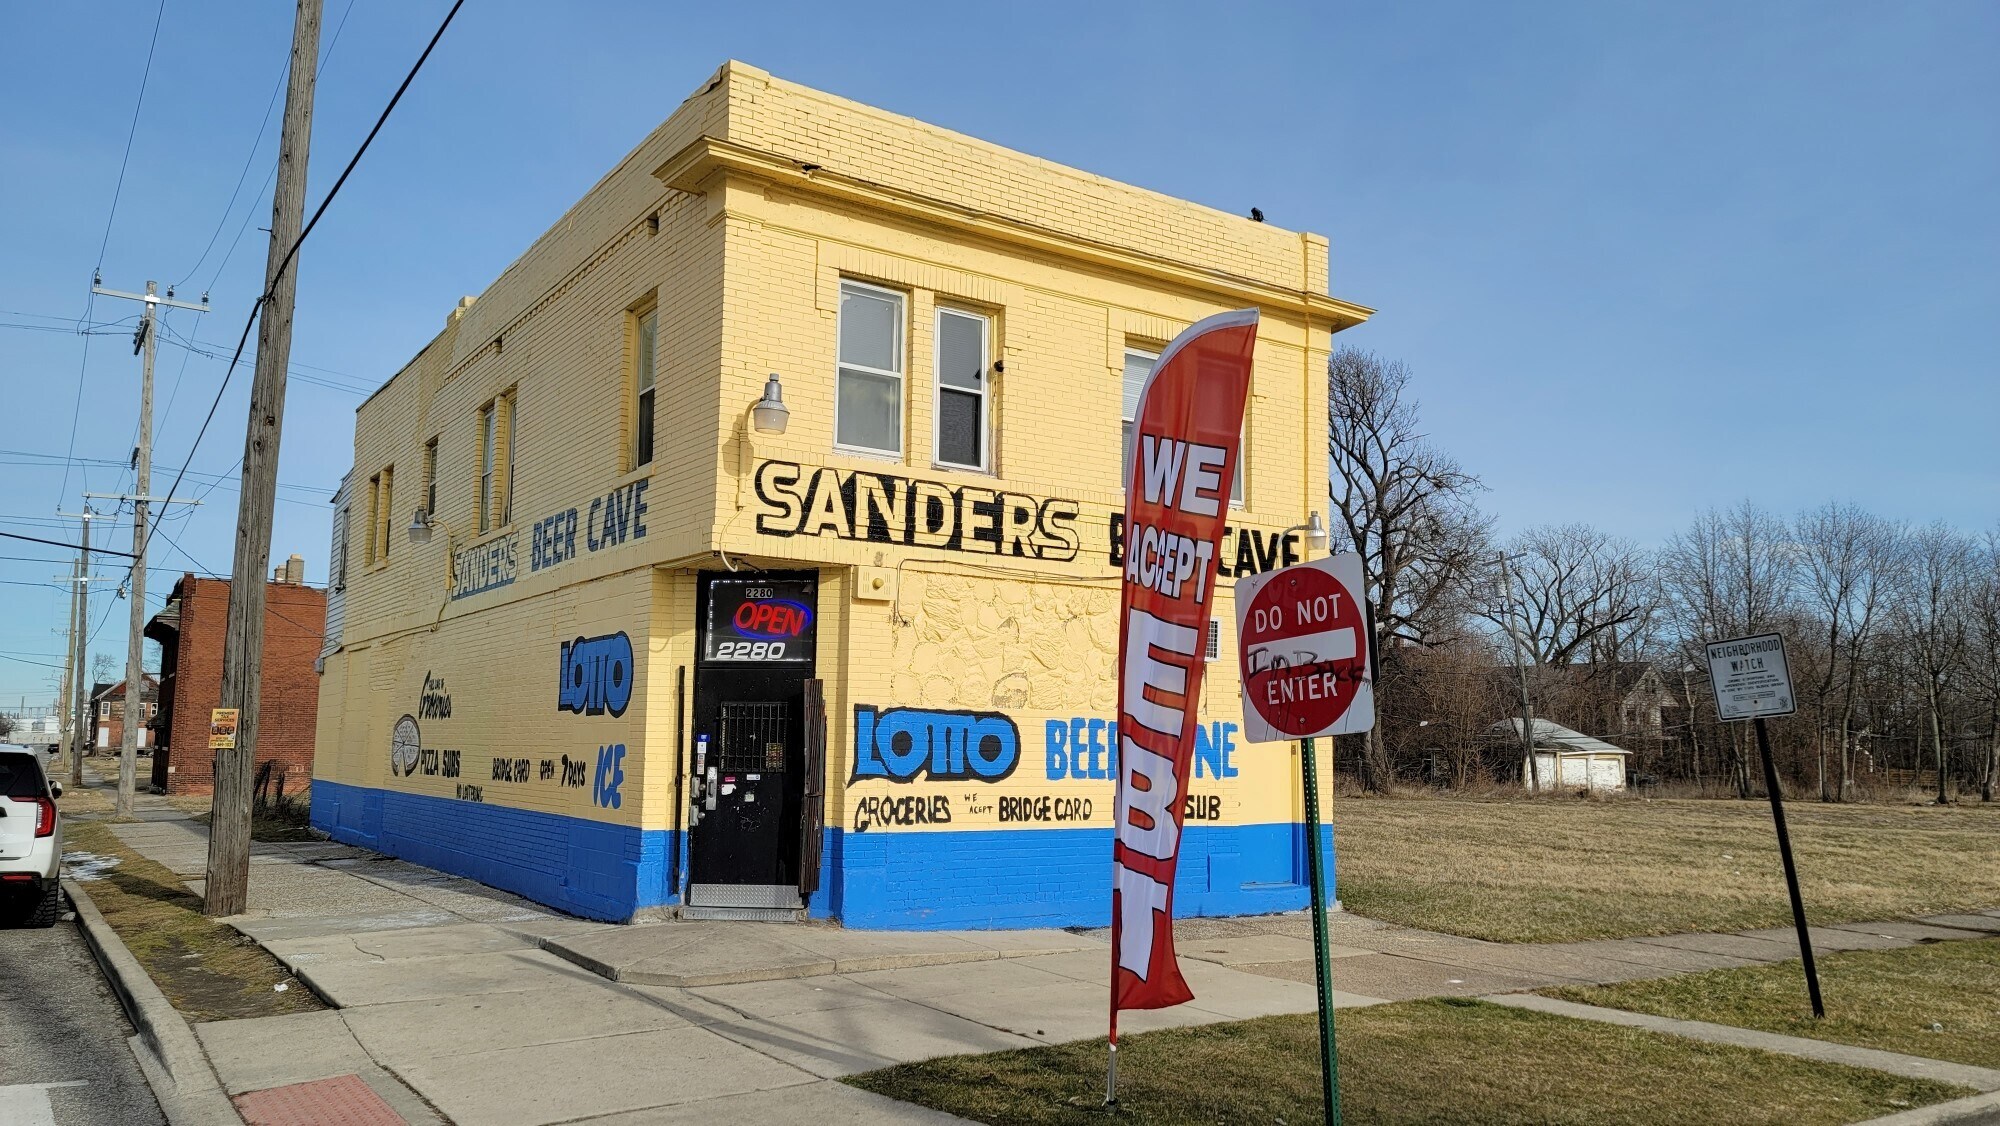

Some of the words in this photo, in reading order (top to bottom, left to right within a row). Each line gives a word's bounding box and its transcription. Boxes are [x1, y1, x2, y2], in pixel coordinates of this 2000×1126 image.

[1141, 433, 1228, 518] WE
[754, 460, 1080, 562] SANDERS
[452, 532, 519, 600] SANDERS
[531, 507, 578, 572] BEER
[587, 478, 649, 552] CAVE
[1126, 523, 1215, 605] ACCEPT
[746, 588, 773, 598] 2280
[735, 602, 805, 636] OPEN
[1254, 605, 1283, 634] DO
[1297, 593, 1342, 626] NOT
[716, 642, 786, 660] 2280
[1710, 640, 1779, 659] NEIGHBORHOOD
[558, 631, 634, 718] LOTTO
[1267, 672, 1338, 705] ENTER
[847, 703, 1022, 786] LOTTO
[1195, 721, 1239, 780] NE
[420, 749, 439, 776] PIZZA
[442, 749, 461, 778] SUBS
[492, 757, 513, 783] BRIDGE
[514, 758, 530, 783] CARD
[540, 759, 555, 781] OPEN
[561, 753, 568, 787] 7
[568, 760, 586, 789] DAYS
[593, 744, 626, 809] ICE
[964, 793, 978, 802] WE
[969, 805, 993, 814] ACEPT
[998, 796, 1051, 822] BRIDGE
[1054, 797, 1092, 821] CARD
[1114, 607, 1199, 983] EBT
[1184, 795, 1222, 821] SUB
[854, 795, 952, 833] GROCERIES
